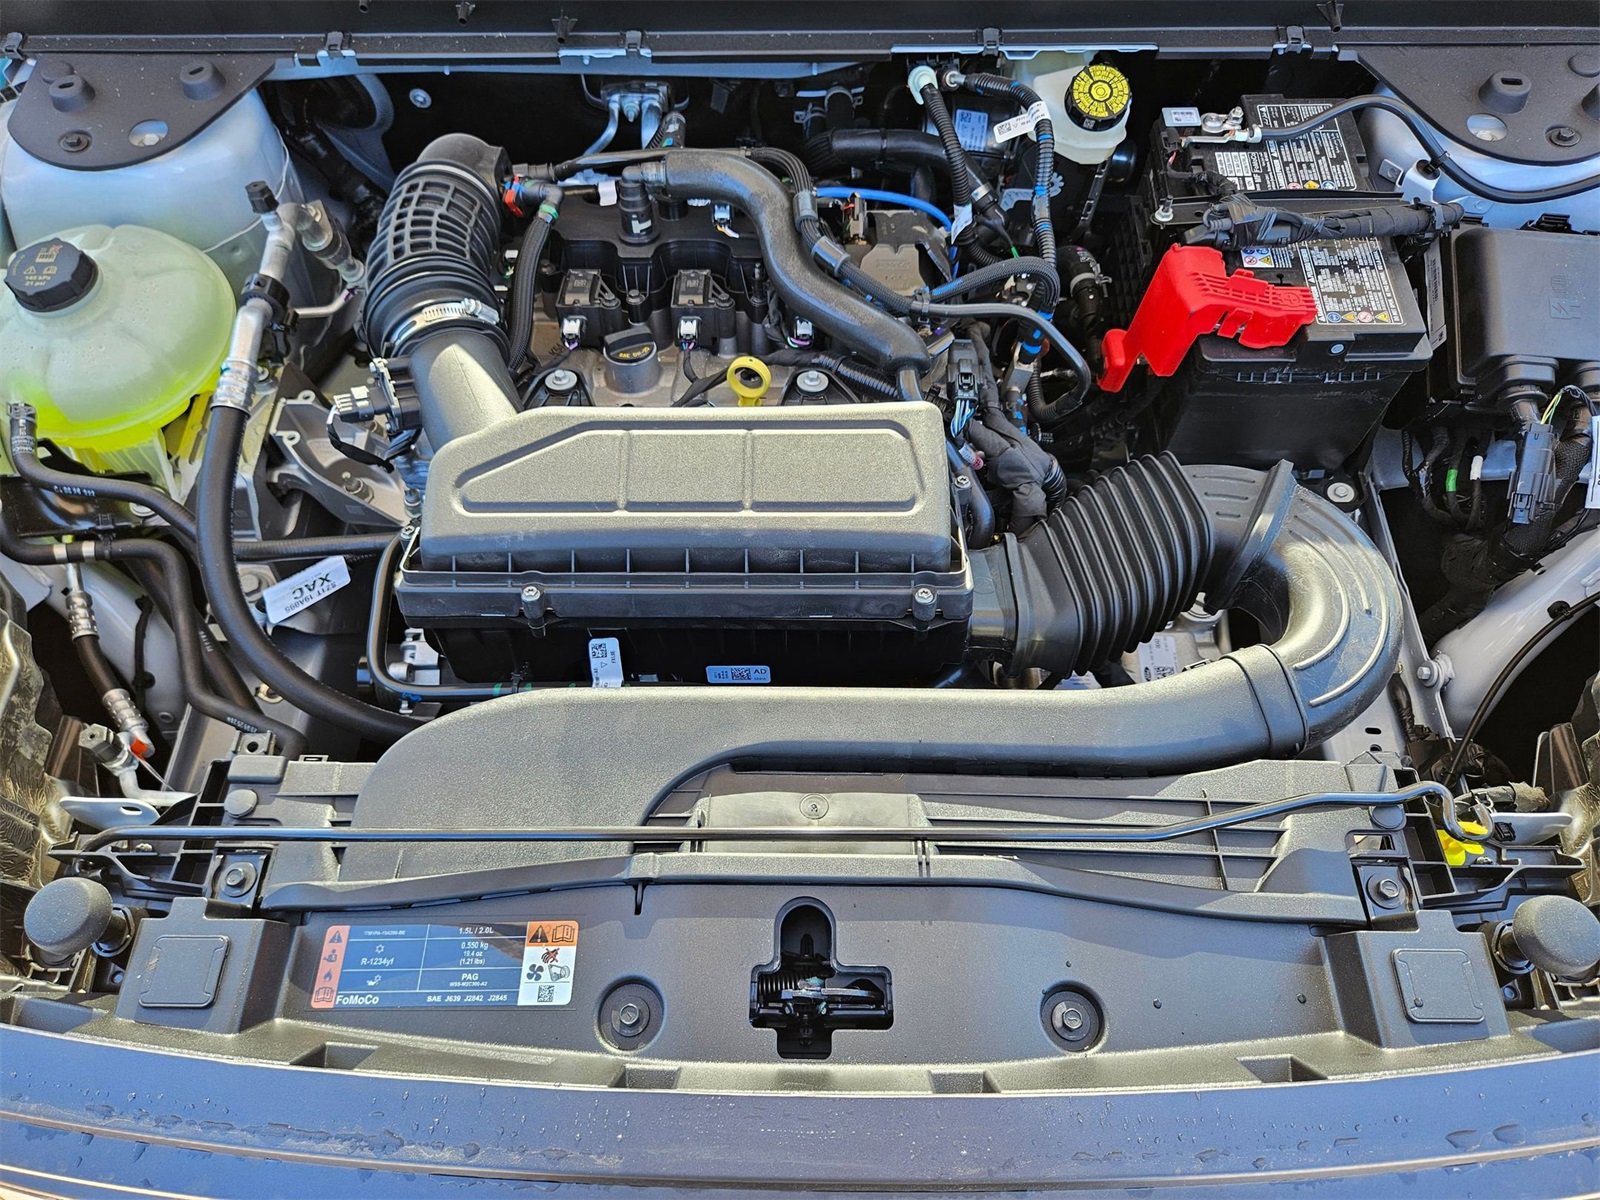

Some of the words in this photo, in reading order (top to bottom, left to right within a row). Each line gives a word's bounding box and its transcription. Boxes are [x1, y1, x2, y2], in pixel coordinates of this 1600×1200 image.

[1250, 152, 1261, 173] FoMoCo
[292, 572, 331, 600] XAC
[459, 927, 473, 935] 1.5L
[461, 941, 479, 950] 0.550
[480, 941, 489, 951] kg
[360, 957, 395, 967] R-1234yf
[474, 958, 486, 966] lbs)
[461, 973, 479, 981] PAG
[335, 993, 380, 1005] FoMoCo
[426, 994, 442, 1003] SAE
[444, 994, 461, 1002] J639
[464, 994, 484, 1002] J2842
[487, 994, 508, 1002] J2845
